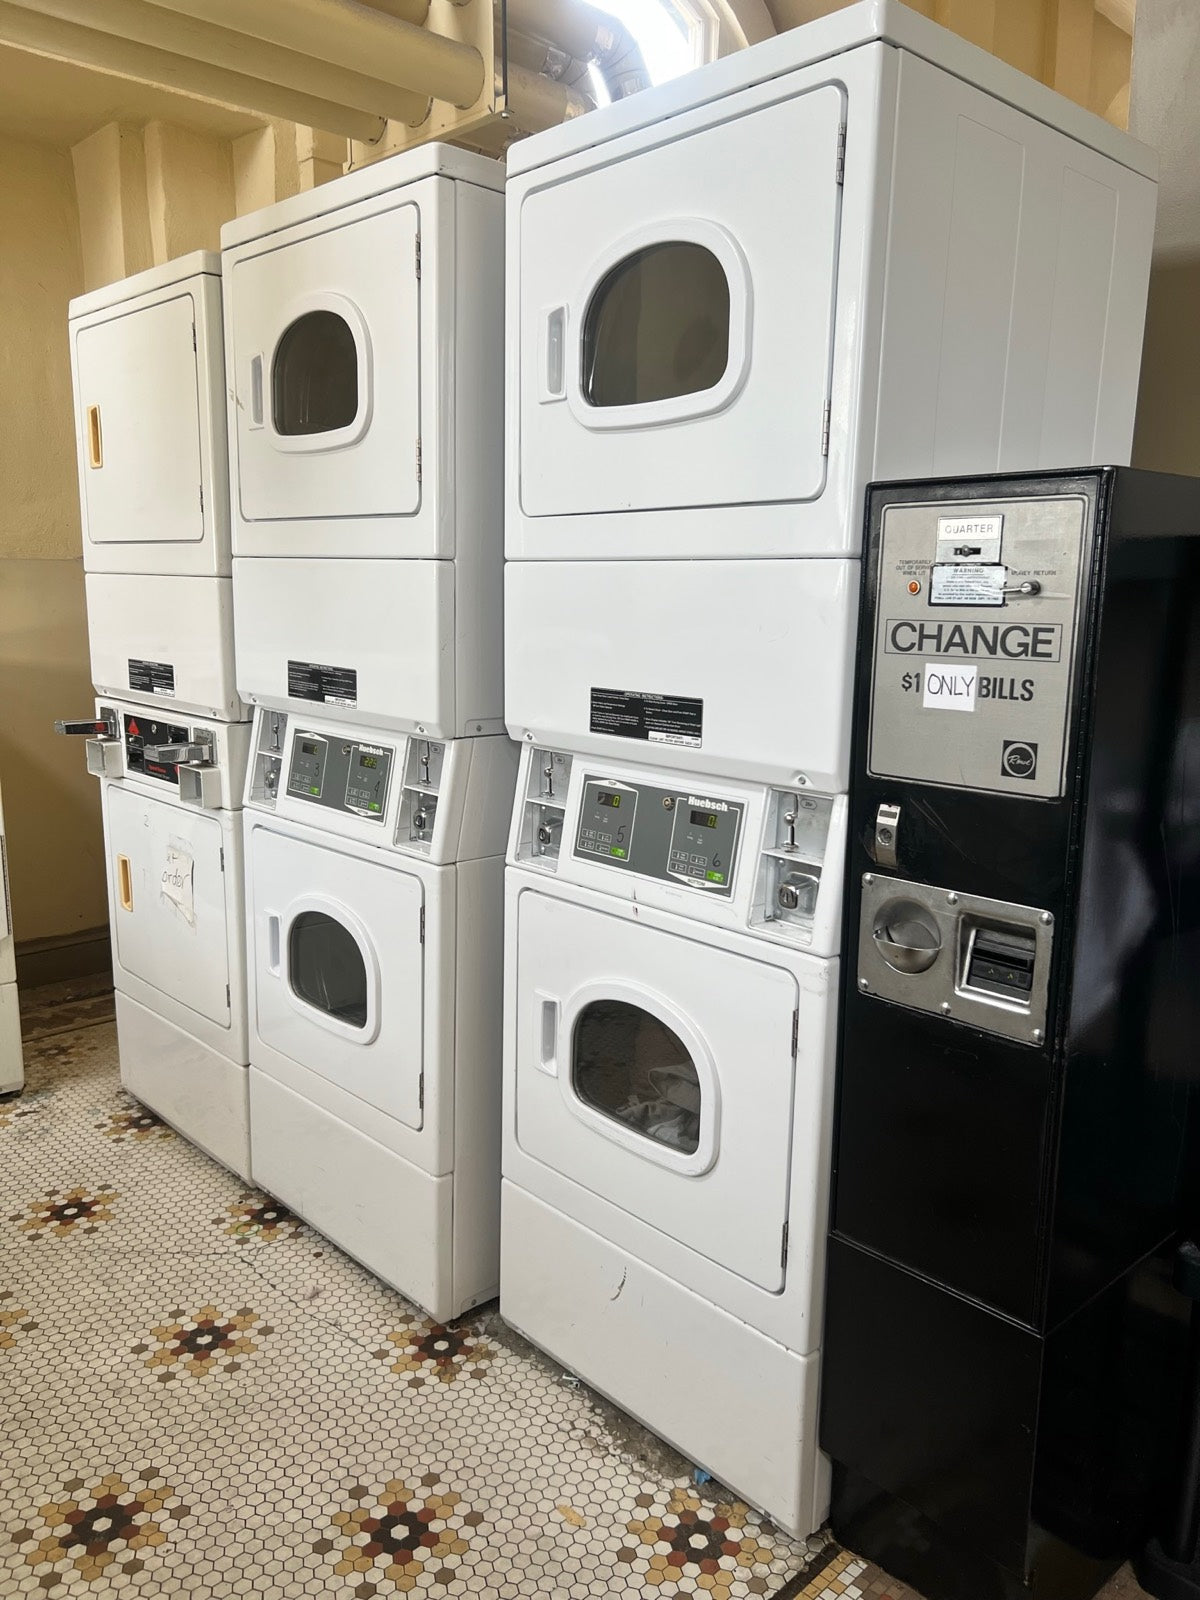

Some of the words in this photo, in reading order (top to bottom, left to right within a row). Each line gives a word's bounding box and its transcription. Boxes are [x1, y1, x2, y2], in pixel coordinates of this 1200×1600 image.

[945, 523, 994, 535] QUARTER
[890, 621, 1056, 658] CHANGE
[901, 672, 921, 693] $1
[977, 676, 1035, 701] BILLS
[927, 673, 975, 697] ONLY
[358, 744, 384, 757] Huebsch
[313, 762, 320, 778] 3
[374, 780, 381, 799] 4
[612, 795, 620, 808] 0
[687, 796, 729, 812] Huebsch
[616, 825, 627, 844] 5
[711, 852, 722, 868] 6
[161, 868, 191, 889] order
